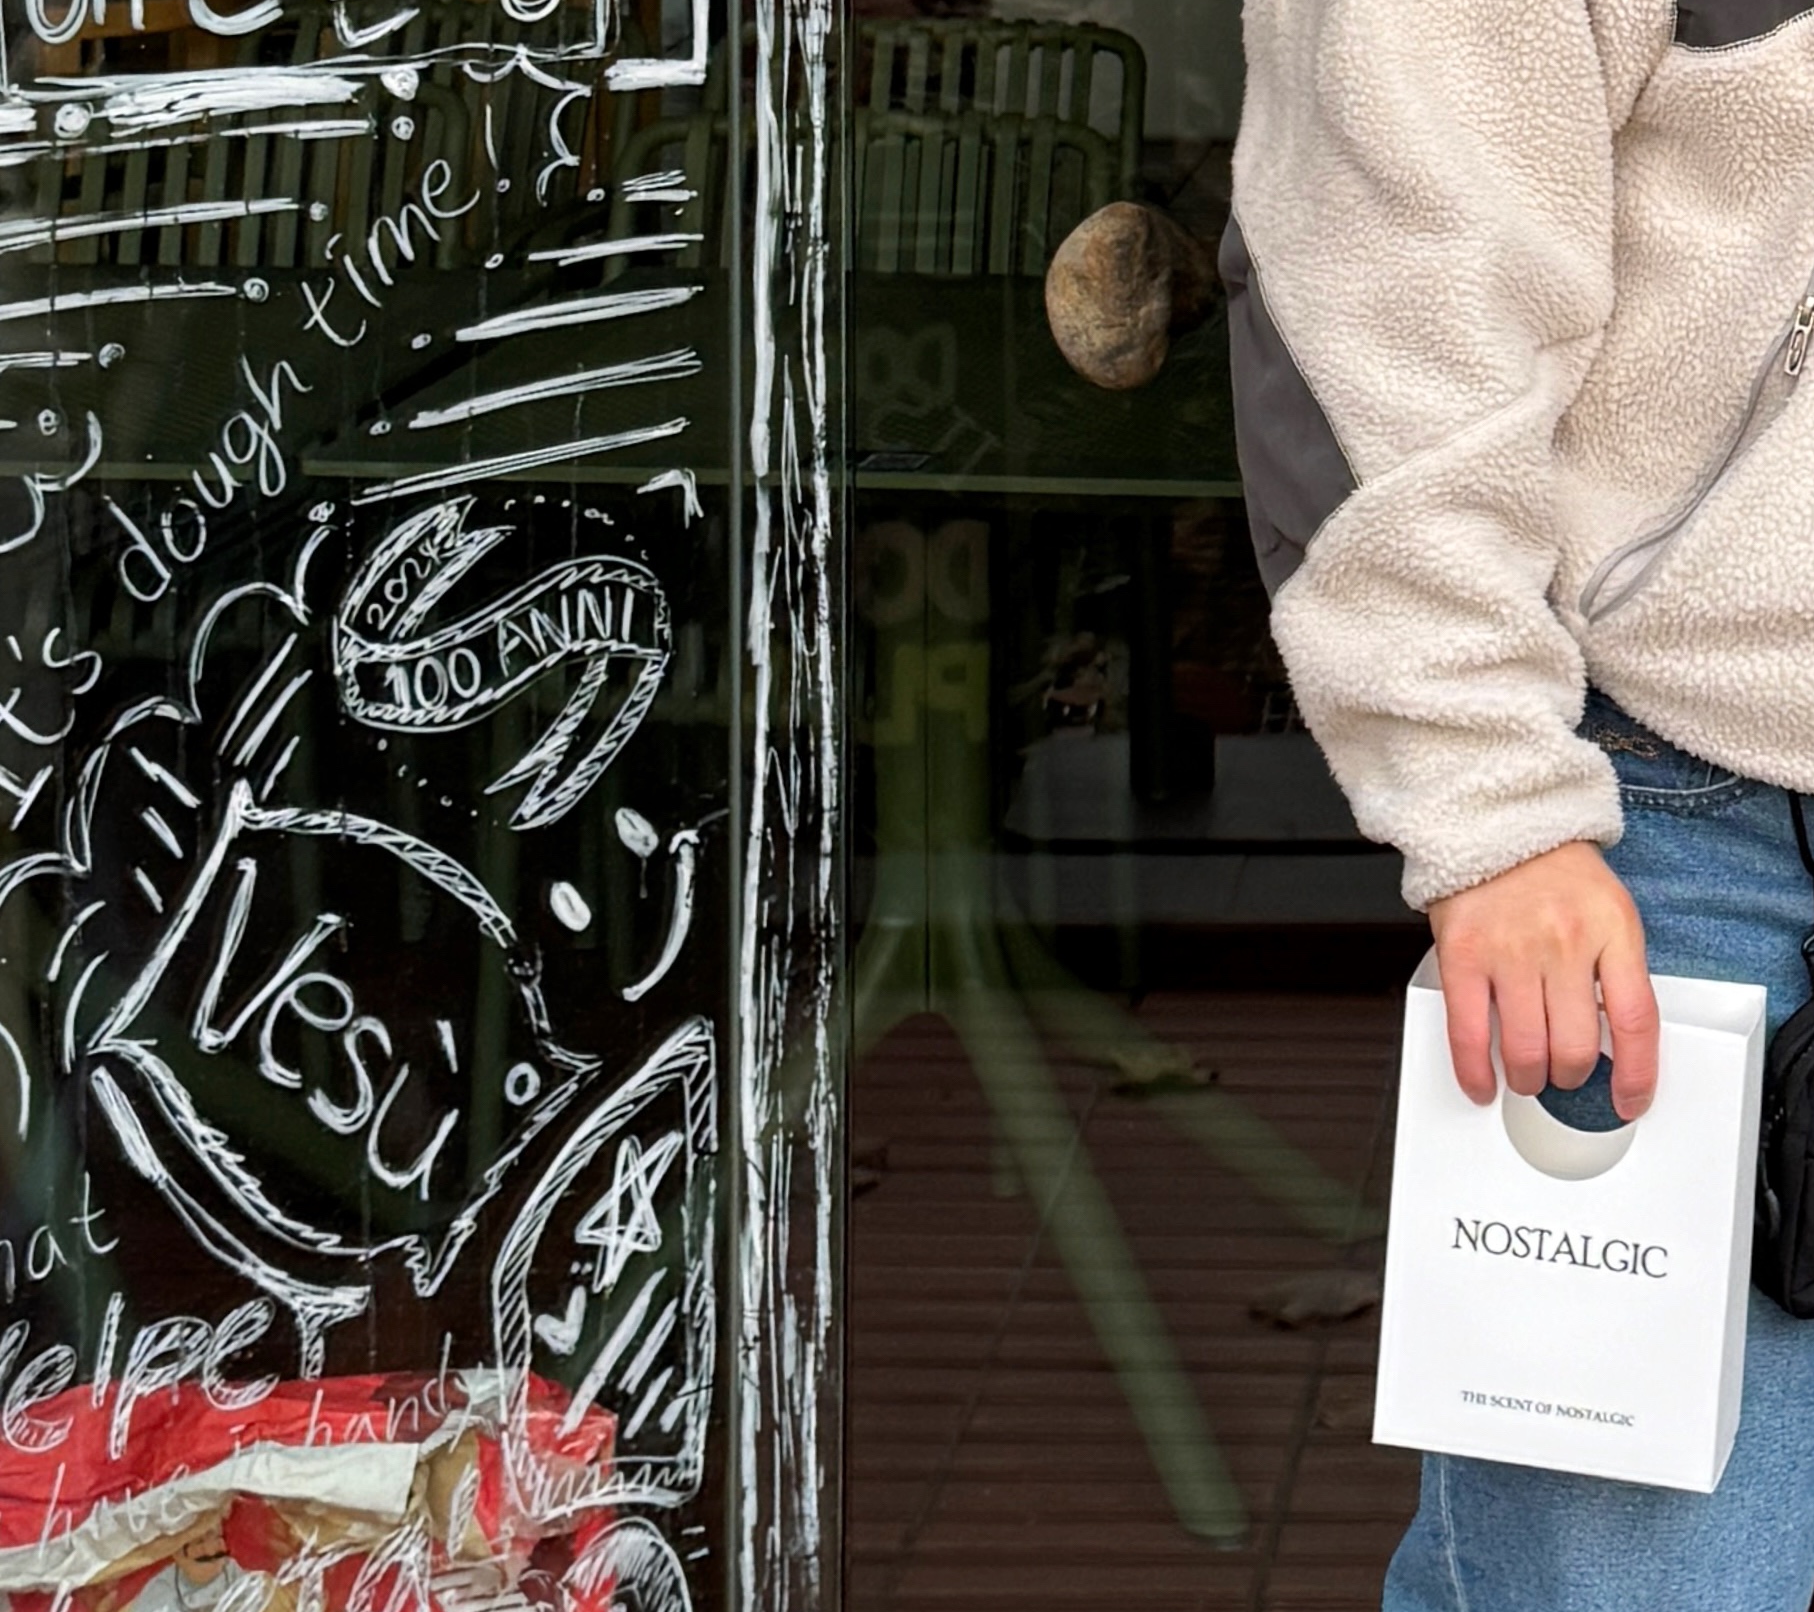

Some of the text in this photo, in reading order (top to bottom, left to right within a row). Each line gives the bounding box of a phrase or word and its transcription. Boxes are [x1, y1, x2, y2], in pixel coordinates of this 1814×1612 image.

[103, 354, 312, 602] dough
[365, 537, 443, 632] 2024
[384, 586, 635, 711] 100 ANNI
[1452, 1217, 1669, 1279] NOSTALGIC
[1461, 1390, 1636, 1428] THE SCENT OF NOSTALGIC
